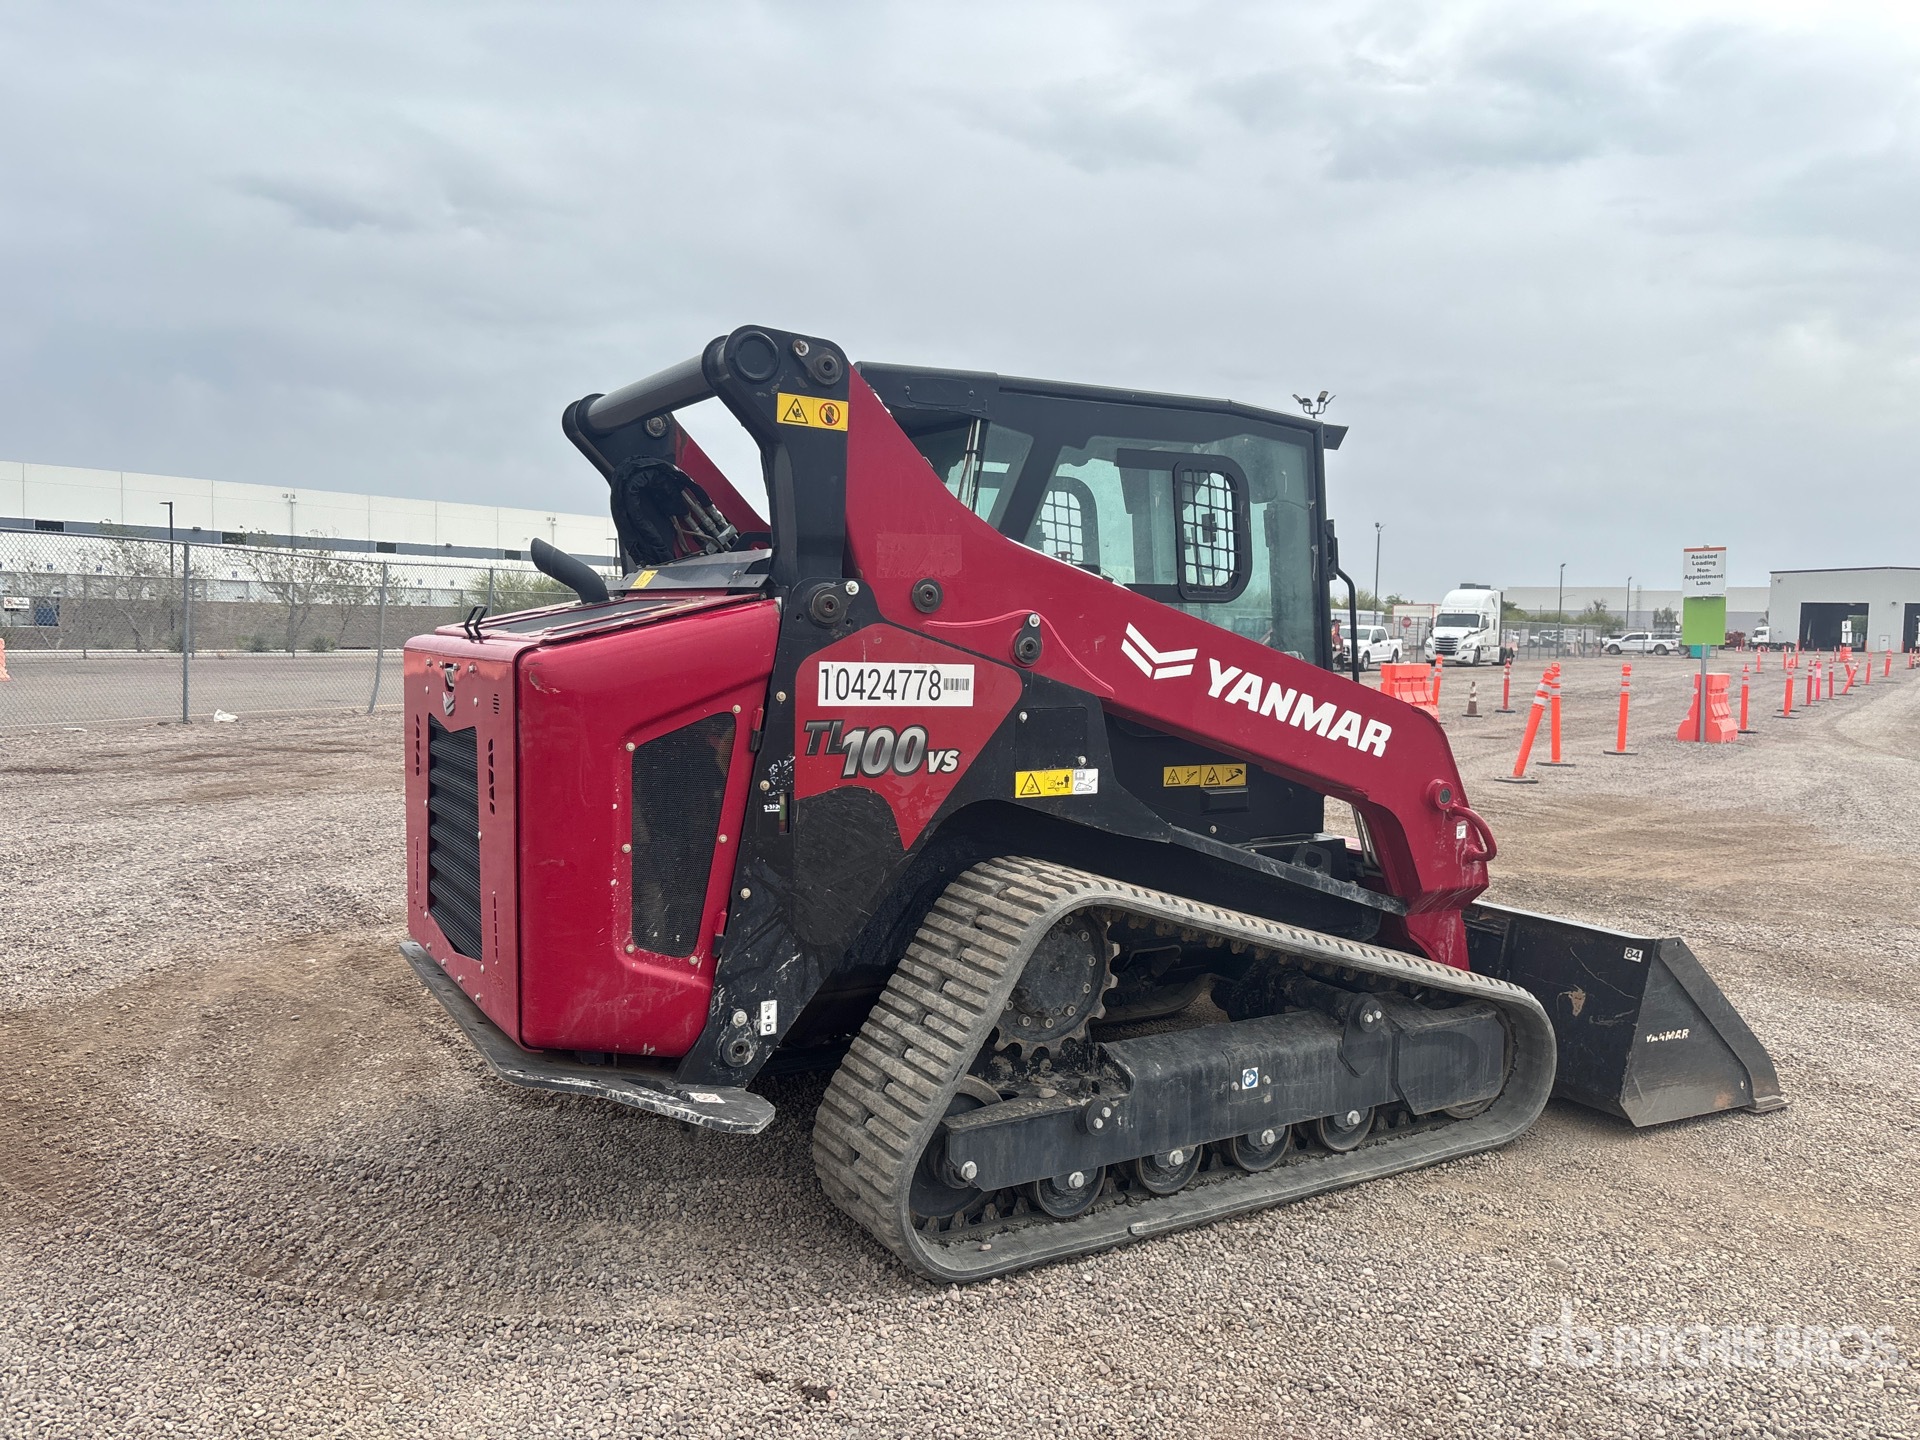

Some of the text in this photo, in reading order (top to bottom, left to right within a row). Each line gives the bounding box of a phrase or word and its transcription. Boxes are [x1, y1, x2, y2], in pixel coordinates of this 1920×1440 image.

[821, 668, 942, 701] 10424778
[1207, 658, 1393, 758] YANMAR
[1625, 949, 1640, 961] 84
